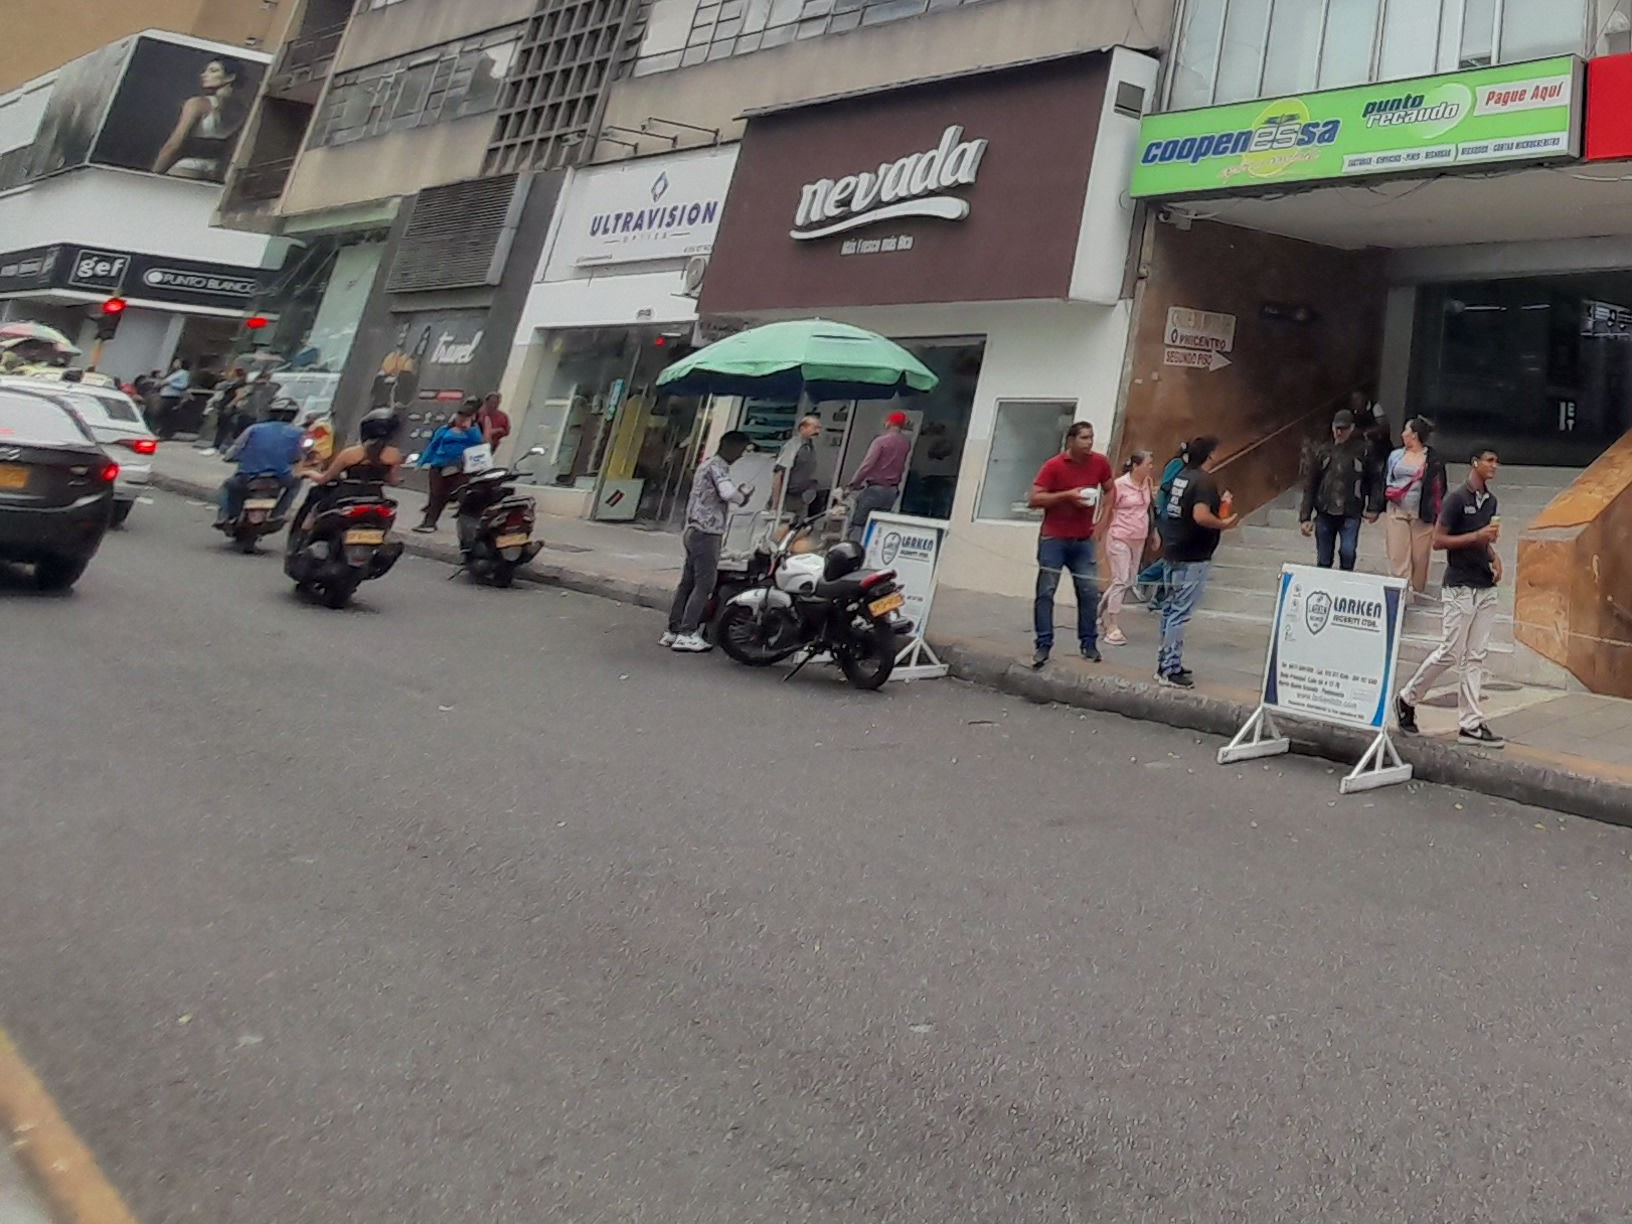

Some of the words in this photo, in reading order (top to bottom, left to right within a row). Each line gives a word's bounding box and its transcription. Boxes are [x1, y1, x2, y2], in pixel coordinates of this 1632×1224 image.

[1363, 94, 1425, 118] punto
[1485, 87, 1527, 107] Pague
[1530, 81, 1563, 101] Aquí
[1367, 102, 1459, 128] recaudo
[795, 125, 988, 226] nevada
[589, 201, 718, 238] ULTRAVISION
[76, 256, 125, 278] gef
[163, 273, 207, 289] PUNTO
[1333, 595, 1382, 619] LARKEN
